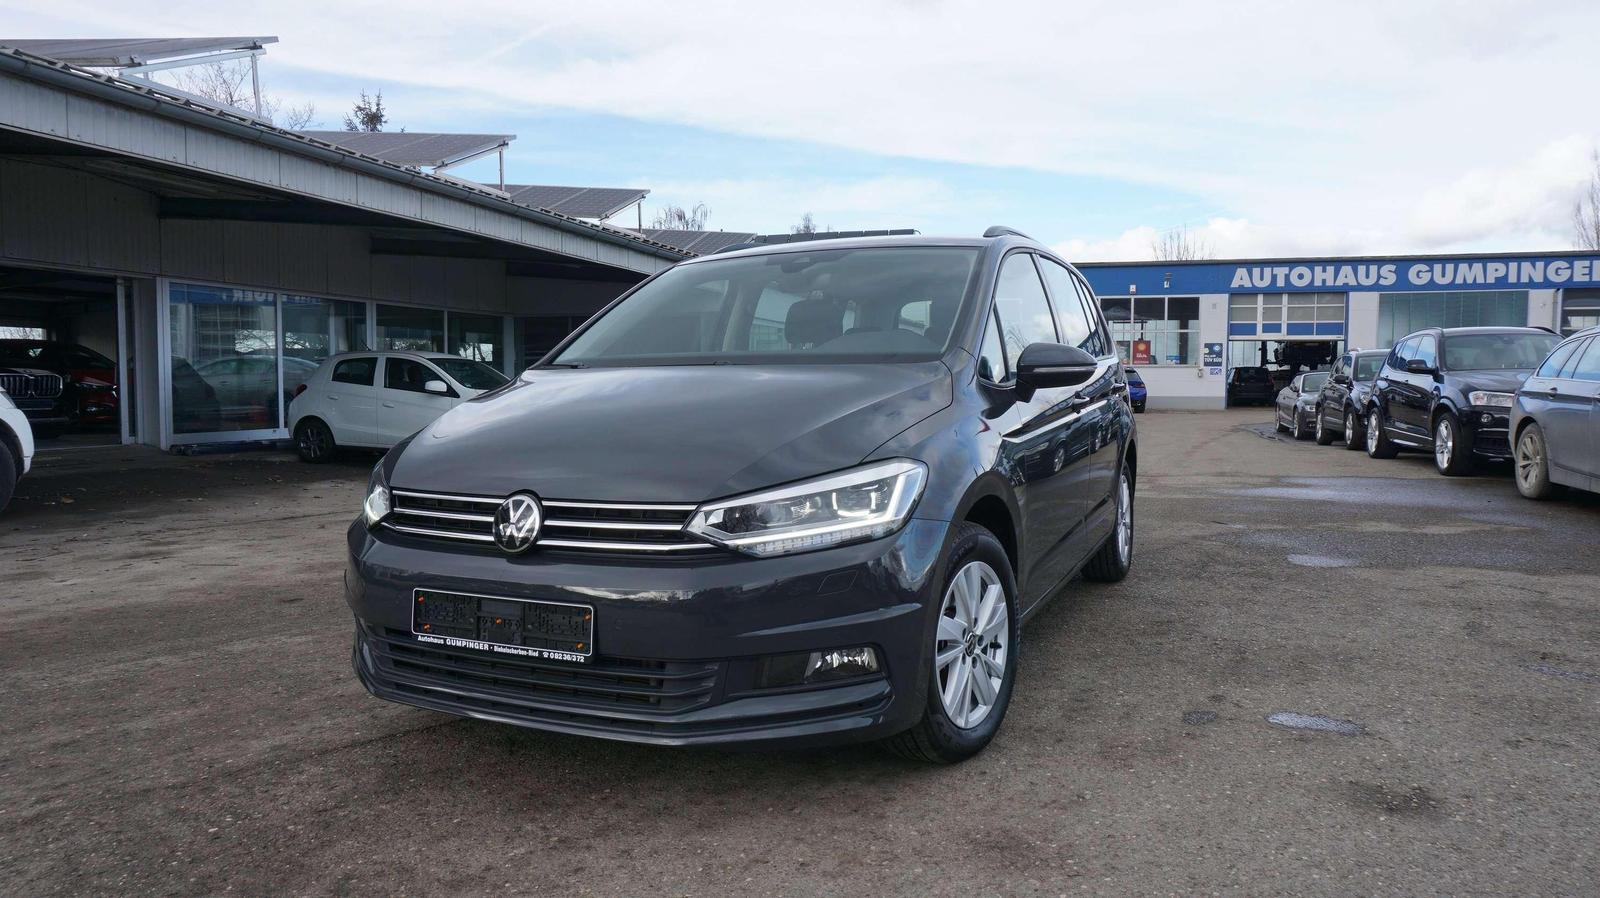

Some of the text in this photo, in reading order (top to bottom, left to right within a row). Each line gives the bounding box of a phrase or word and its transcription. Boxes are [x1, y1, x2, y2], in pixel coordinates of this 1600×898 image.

[1230, 264, 1397, 288] AUTOHAUS
[417, 635, 445, 644] Autohaus
[446, 638, 489, 650] GUMPINGER
